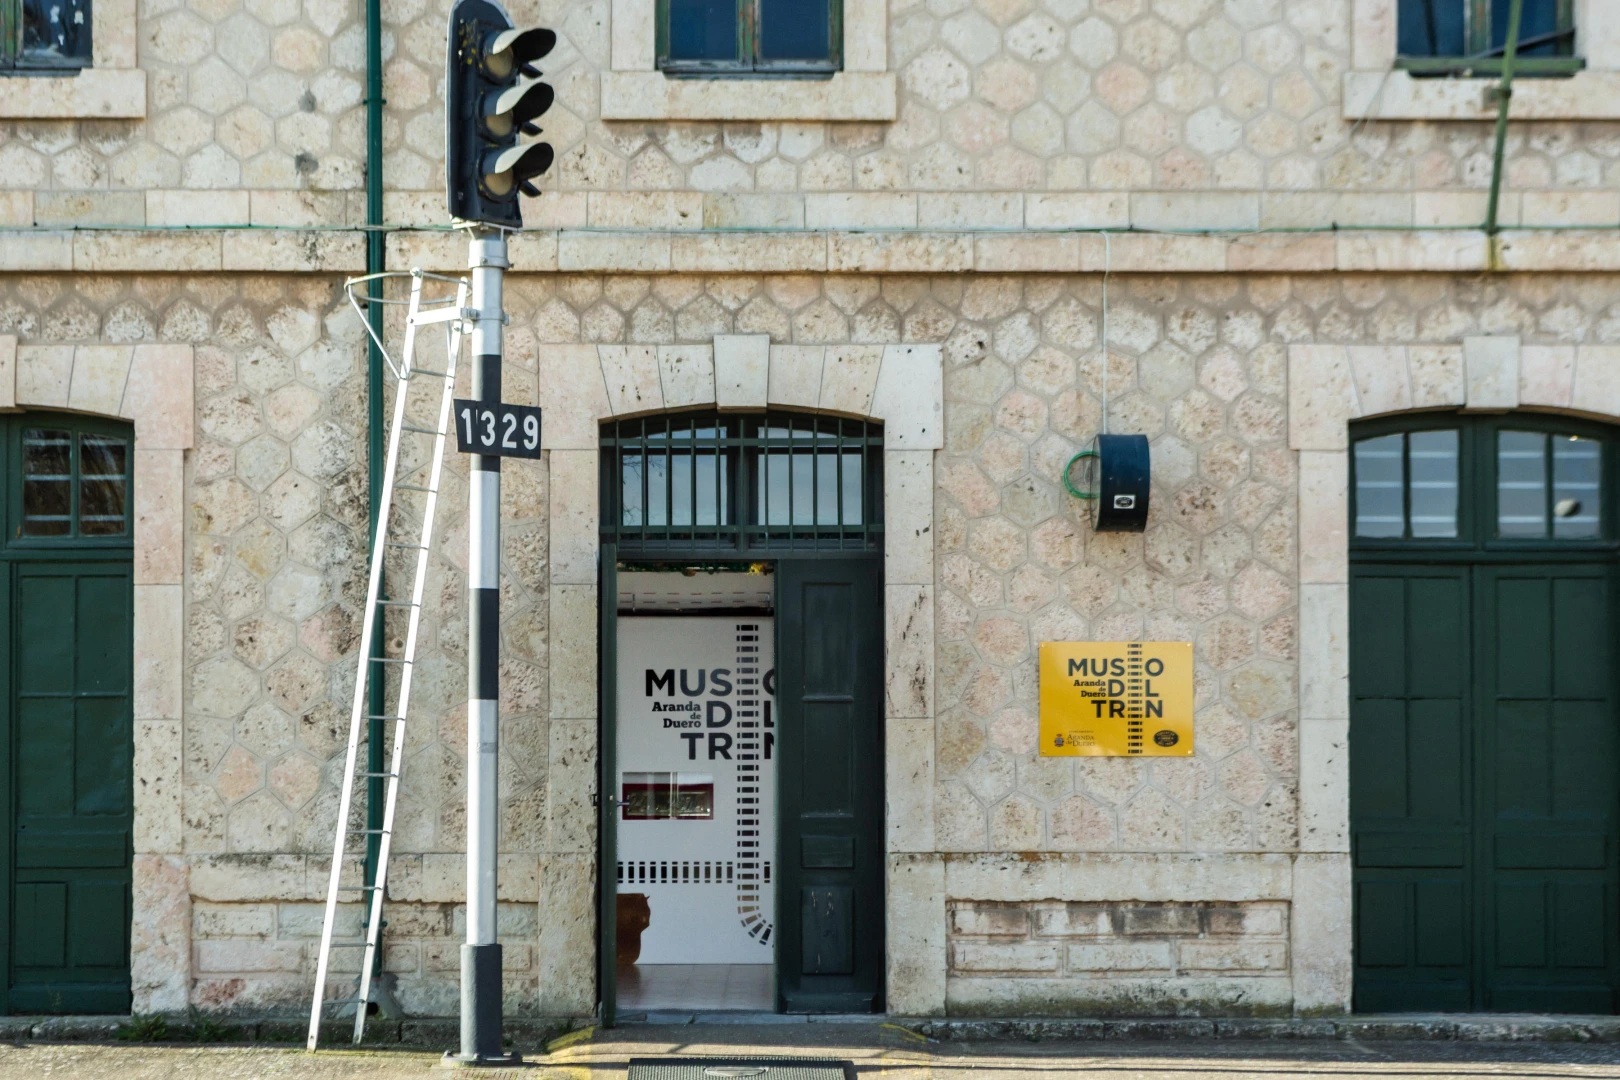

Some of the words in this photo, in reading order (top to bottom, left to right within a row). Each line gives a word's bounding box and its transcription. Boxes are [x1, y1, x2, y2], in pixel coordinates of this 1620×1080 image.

[460, 408, 538, 450] 1329
[1073, 679, 1106, 687] Aranda
[1081, 690, 1106, 698] Duero
[652, 701, 701, 712] Aranda
[690, 712, 701, 720] de
[663, 718, 701, 728] Duero
